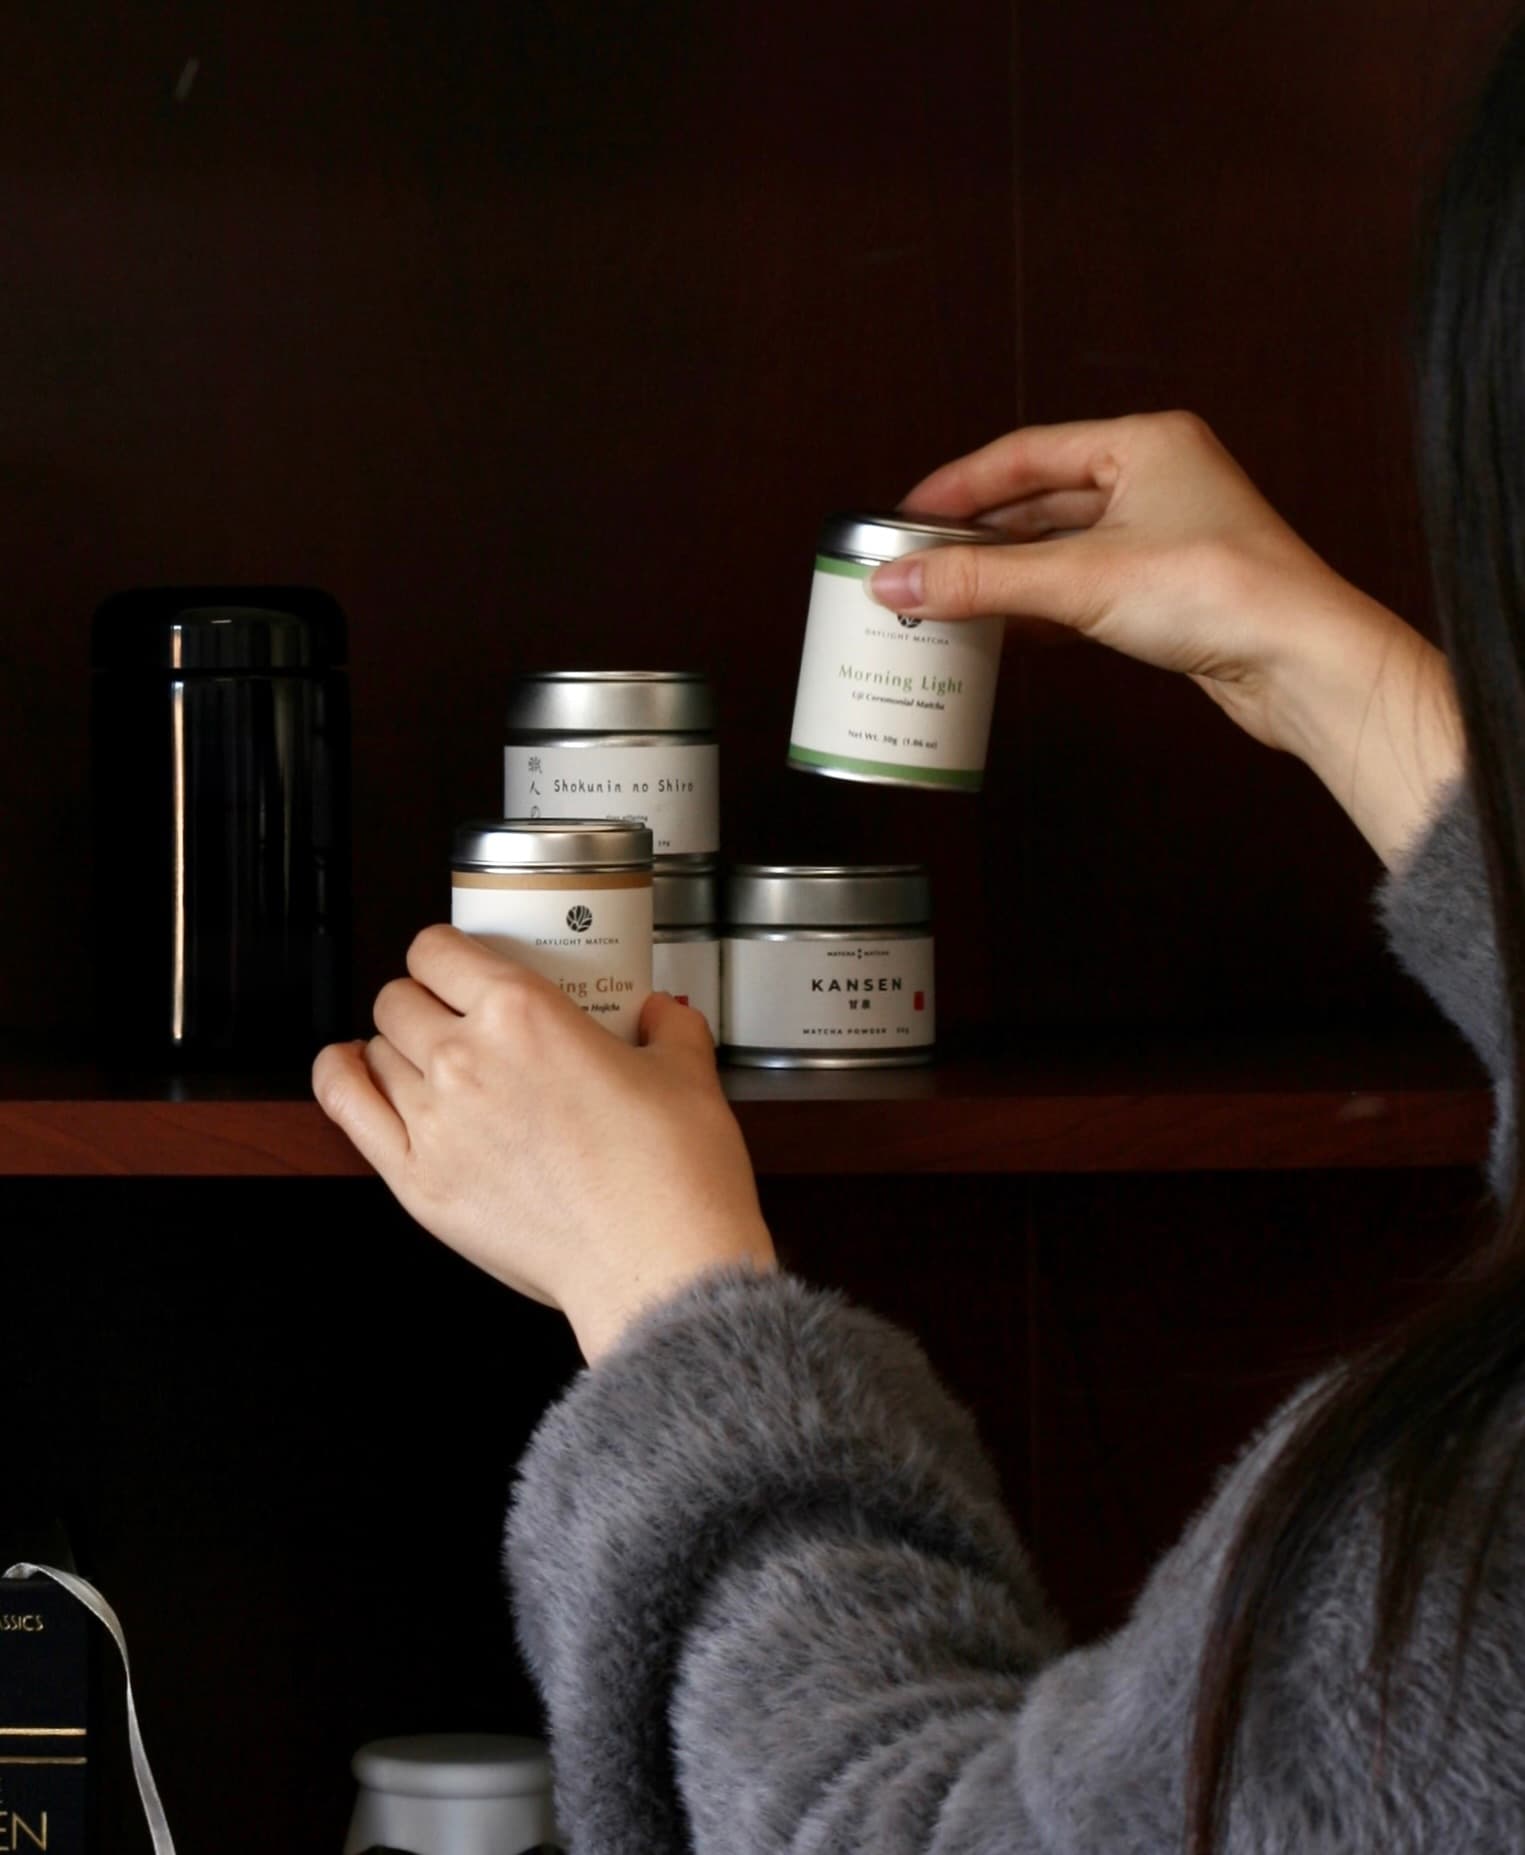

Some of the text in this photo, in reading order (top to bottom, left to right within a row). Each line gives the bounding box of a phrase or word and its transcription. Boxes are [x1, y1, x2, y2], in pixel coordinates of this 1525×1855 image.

[913, 635, 950, 645] MATCHA
[838, 664, 963, 696] Morning Light
[554, 779, 694, 792] Shokunin no Shiro
[536, 938, 581, 946] DAYLIGHT
[560, 976, 634, 998] ing Glow
[812, 978, 902, 992] KANSEN
[0, 1614, 44, 1631] SSICS
